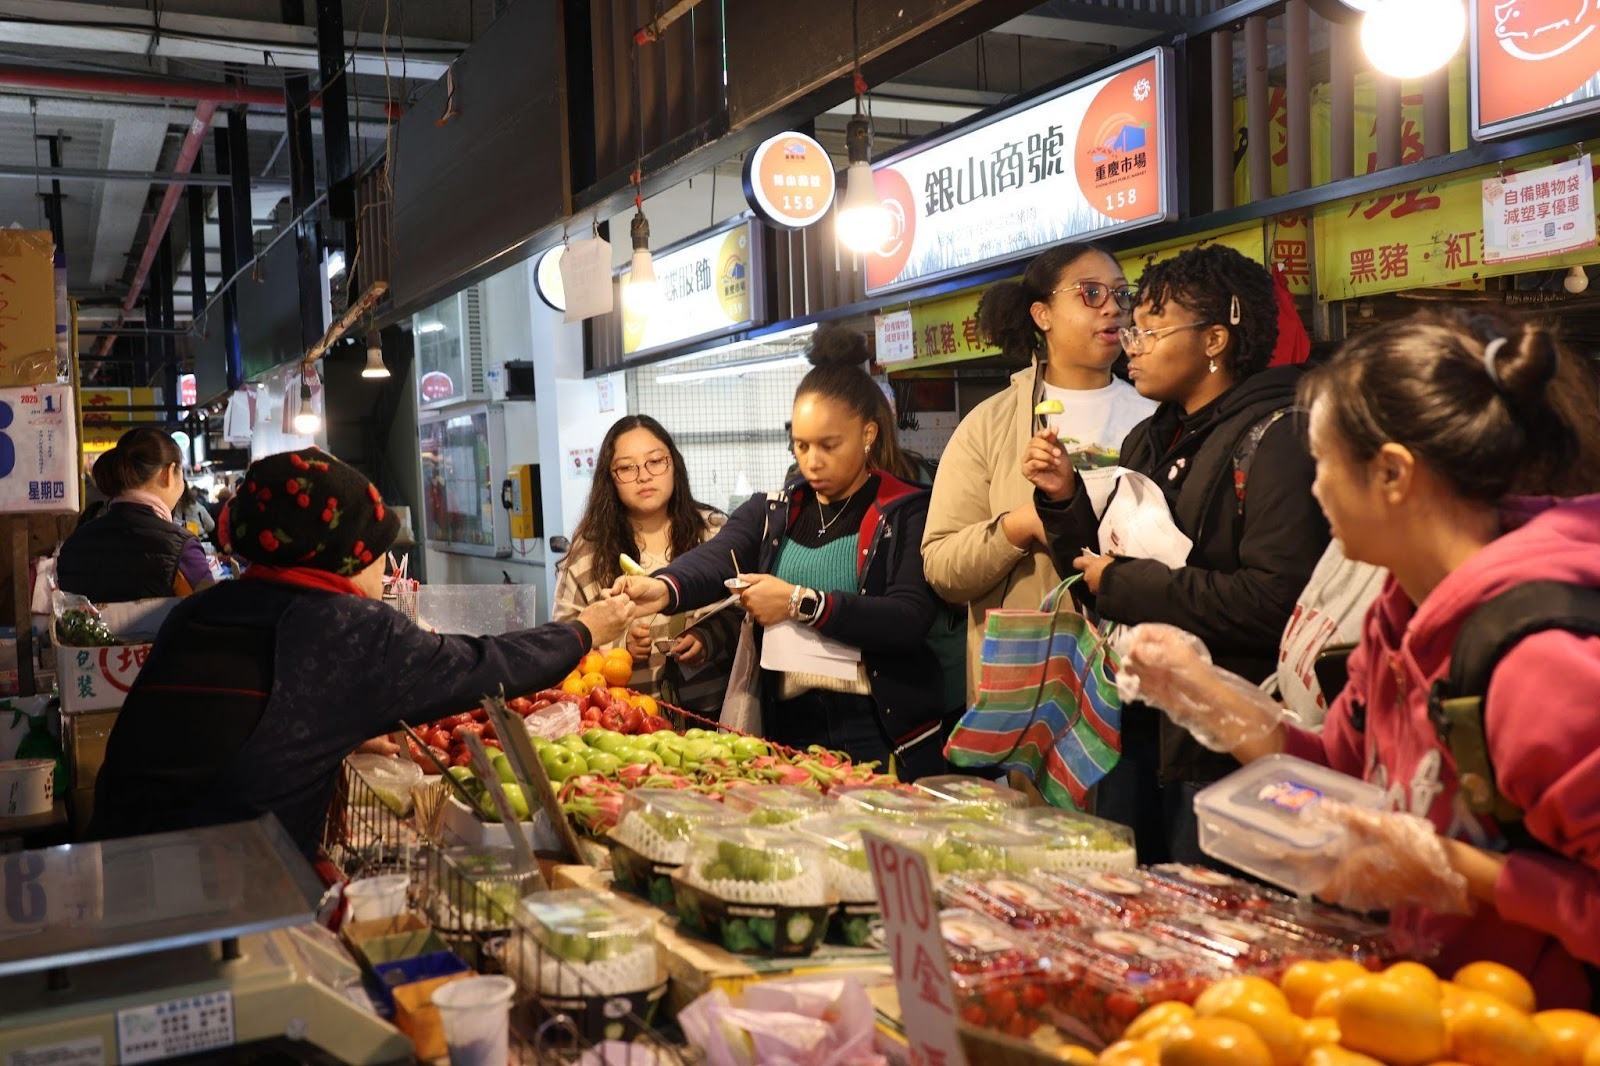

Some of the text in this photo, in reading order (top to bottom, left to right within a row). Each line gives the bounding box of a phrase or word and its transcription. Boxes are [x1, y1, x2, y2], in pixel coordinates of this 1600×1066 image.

[925, 124, 1065, 217] 銀山商號
[1095, 152, 1147, 182] 重慶市場
[782, 195, 815, 211] 158
[1105, 188, 1137, 211] 158
[1504, 174, 1580, 206] 自備購物袋
[1503, 194, 1581, 226] 減塑享優惠
[21, 395, 38, 404] 2025
[28, 481, 64, 500] 星期四
[76, 650, 96, 699] 包裝
[869, 840, 931, 933] 190
